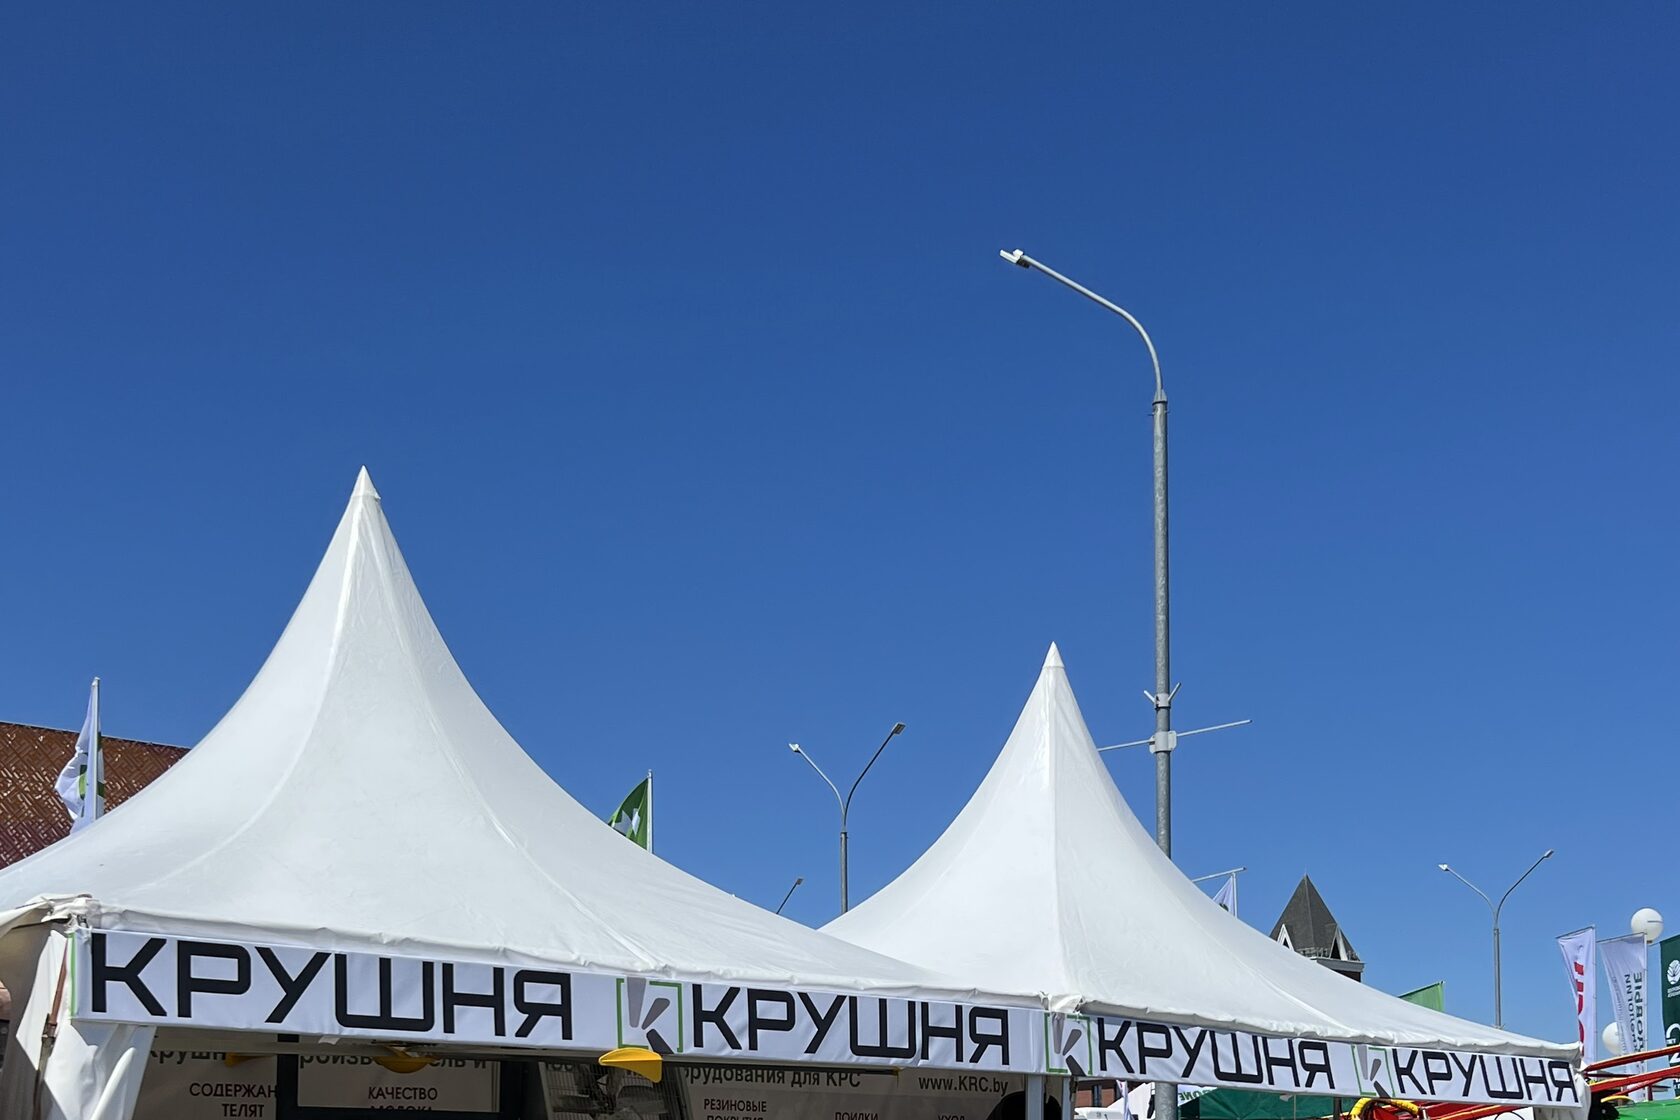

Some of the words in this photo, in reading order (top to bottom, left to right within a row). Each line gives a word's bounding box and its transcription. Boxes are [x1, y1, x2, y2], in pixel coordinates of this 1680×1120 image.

[91, 933, 572, 1040] КРУШНЯ
[692, 984, 1009, 1065] КРУШНЯ
[1097, 1017, 1335, 1089] КРУШНЯ
[791, 1071, 819, 1088] для
[826, 1071, 861, 1087] КРС
[1392, 1049, 1578, 1102] КРУШНЯ
[190, 1083, 278, 1098] СОДЕРЖАН
[368, 1087, 438, 1101] КАЧЕСТВО
[919, 1075, 1008, 1096] www.KRC.by
[222, 1104, 264, 1117] ТЕЛЯТ
[704, 1099, 767, 1112] РЕЗИНОВЫЕ
